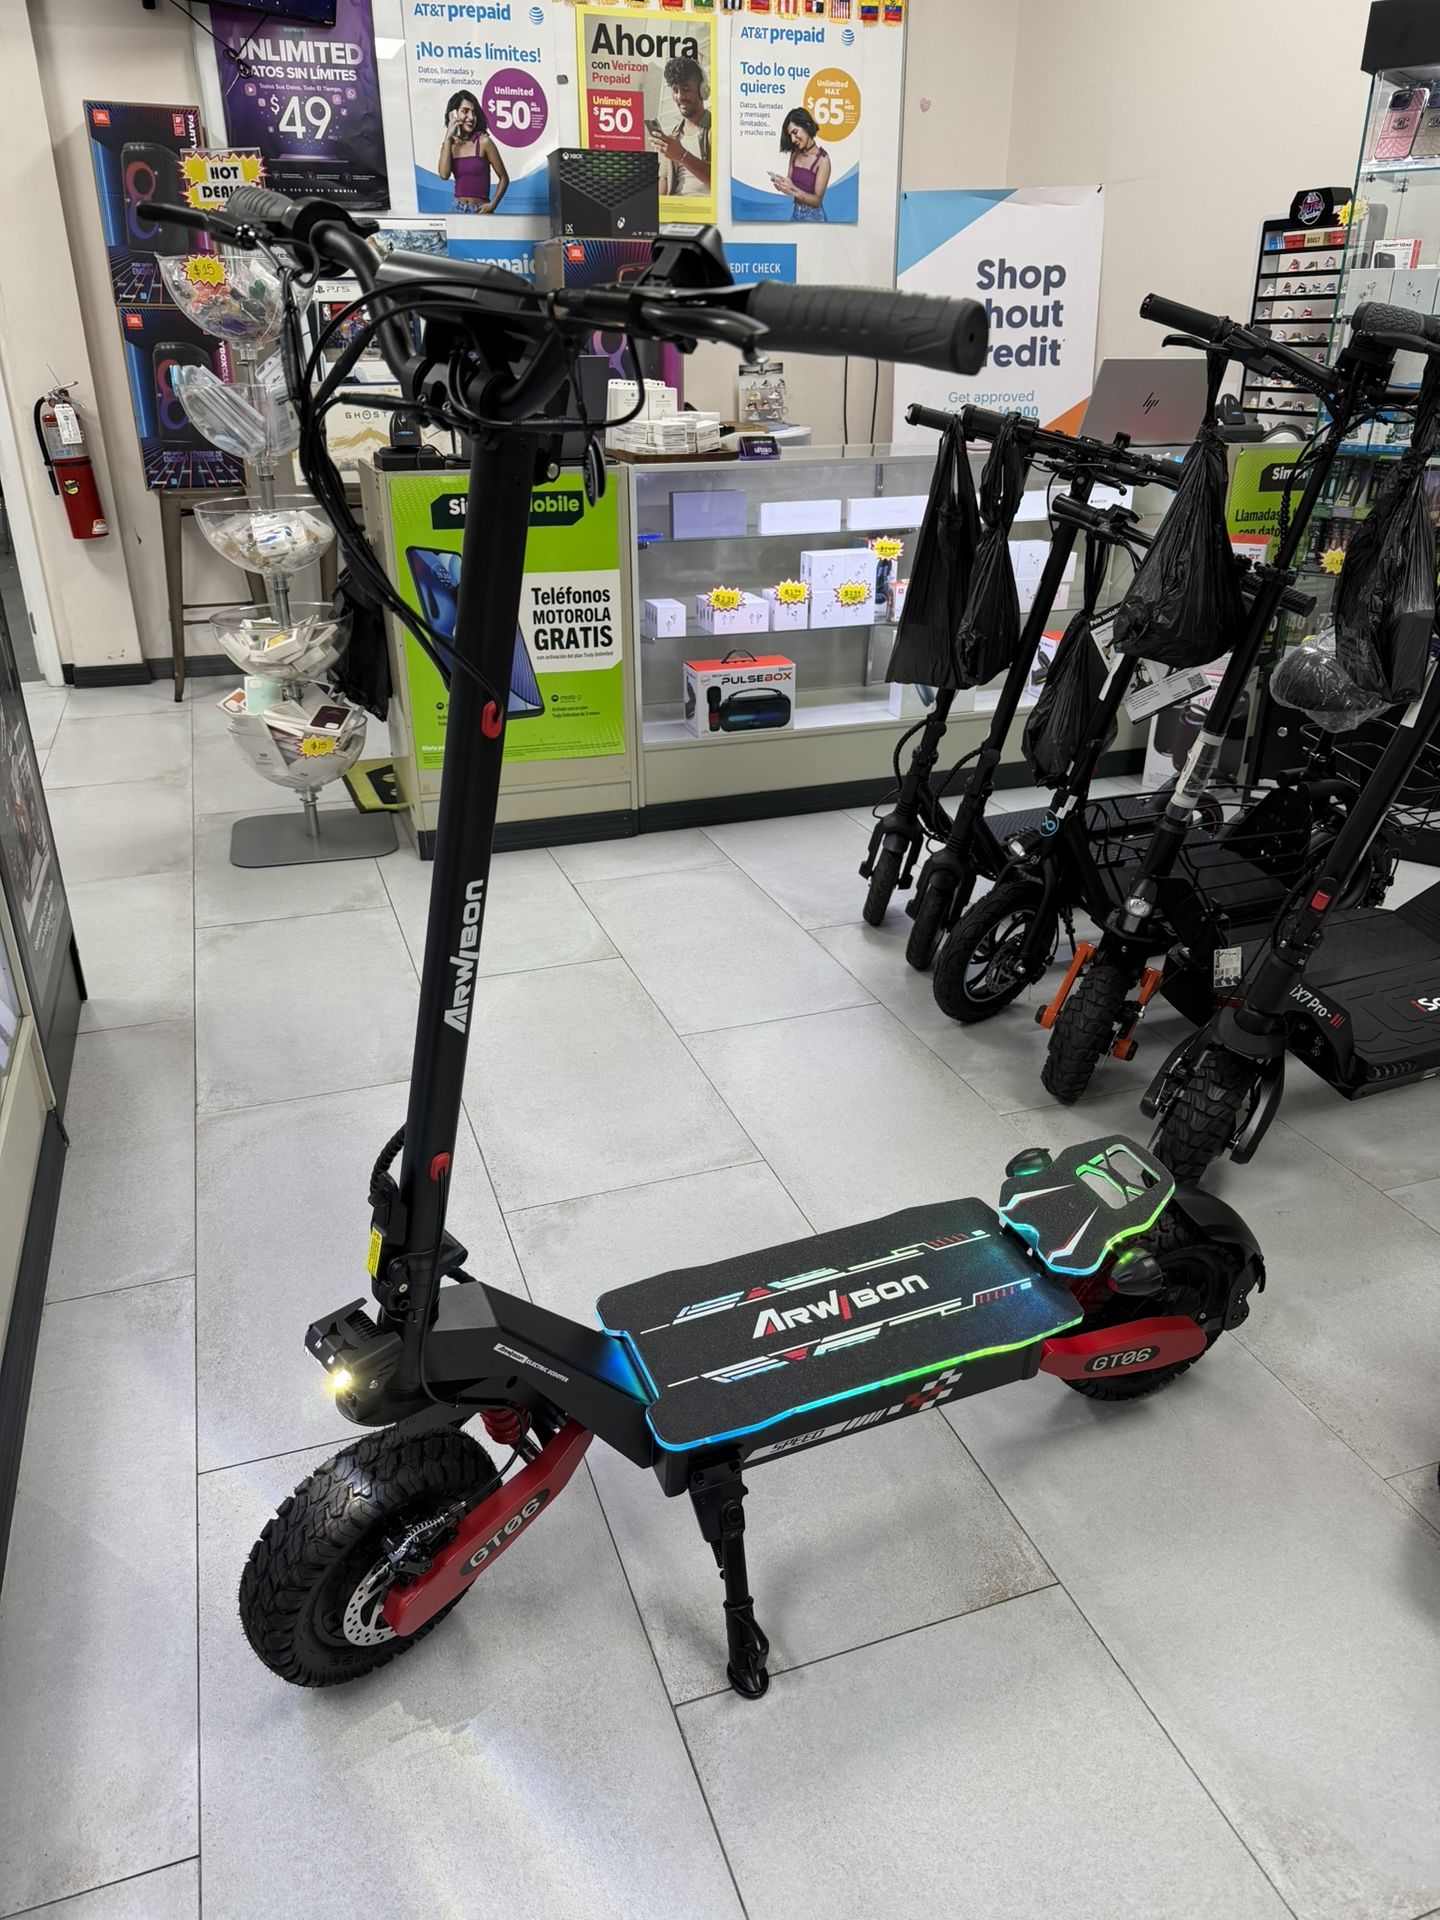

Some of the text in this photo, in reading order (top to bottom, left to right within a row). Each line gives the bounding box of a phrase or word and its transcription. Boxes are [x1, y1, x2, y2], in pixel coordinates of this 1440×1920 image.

[414, 2, 511, 22] AT&T prepaid
[591, 22, 698, 60] Ahorra
[740, 26, 824, 45] AT&T prepaid
[228, 37, 364, 65] UNLIMITED
[416, 41, 542, 63] ¡No más límites!
[240, 65, 358, 81] ATOS SIN LÍMITES
[418, 66, 438, 74] Datos,
[440, 67, 469, 75] llamadas
[592, 60, 648, 72] con Verizon
[740, 62, 810, 80] Todo lo que
[419, 77, 482, 86] mensajes ilimitados
[592, 72, 630, 84] Prepaid
[817, 79, 848, 88] Unlimited
[494, 86, 534, 96] Unlimited
[740, 80, 786, 96] quieres
[592, 96, 632, 106] Unlimited
[758, 102, 784, 110] llamadas
[270, 94, 332, 139] $49
[488, 98, 531, 130] $50
[593, 106, 633, 133] $50
[808, 96, 845, 126] $65
[187, 114, 199, 150] PARTY
[764, 128, 776, 136] más
[210, 167, 239, 180] HOT
[202, 186, 244, 198] DEAL
[194, 264, 216, 276] $15
[730, 262, 782, 274] EDIT CHECK
[976, 258, 1066, 296] Shop
[985, 298, 1064, 328] hout
[982, 336, 1062, 368] redit
[948, 390, 1034, 404] Get approved
[530, 495, 580, 513] obile
[1235, 508, 1280, 522] Llamadas
[1258, 524, 1281, 536] dato
[531, 586, 610, 606] Teléfonos
[532, 607, 612, 624] MOTOROLA
[534, 625, 613, 651] GRATIS
[722, 672, 792, 685] PULSEBOX
[311, 741, 327, 750] $15
[444, 879, 484, 1034] ARWIBON
[752, 1274, 930, 1339] ARWIBON
[1092, 1348, 1152, 1371] GT06
[526, 1359, 549, 1372] ELECTRIC
[547, 1369, 570, 1383] SCOOTER
[770, 1428, 826, 1454] SPEED
[470, 1498, 540, 1568] GT06
